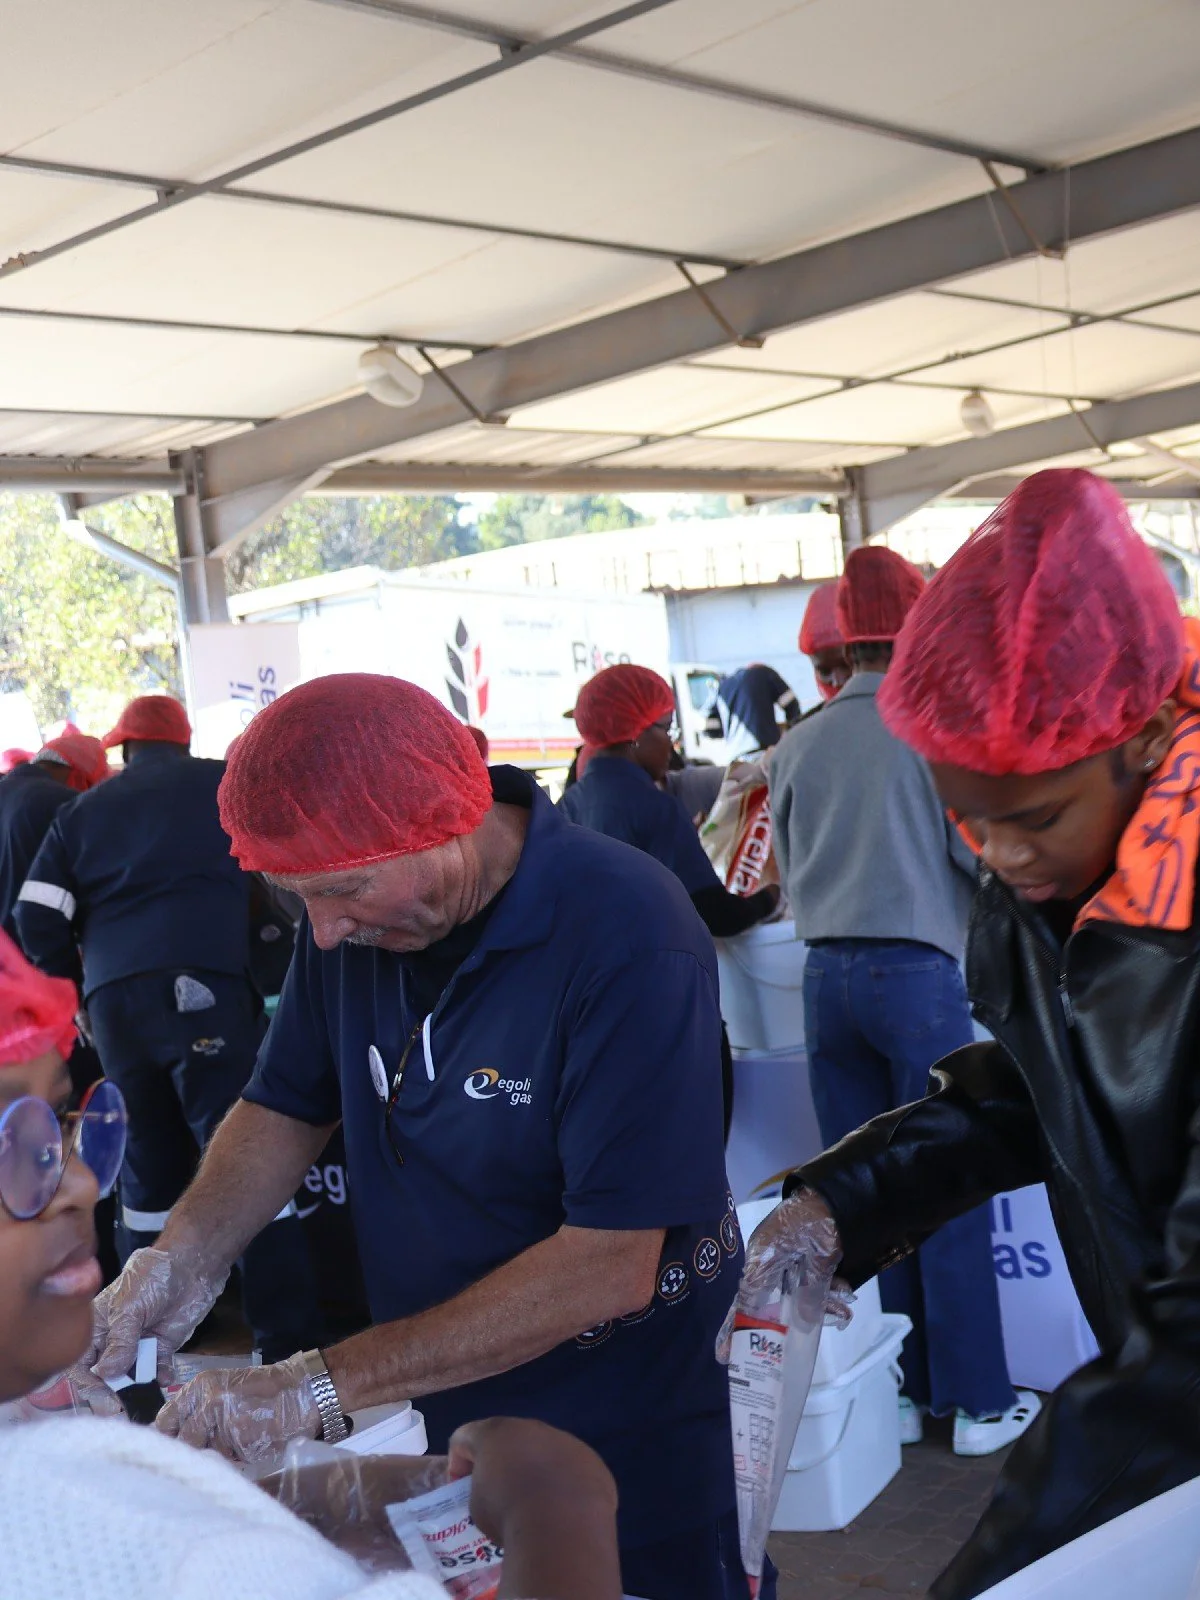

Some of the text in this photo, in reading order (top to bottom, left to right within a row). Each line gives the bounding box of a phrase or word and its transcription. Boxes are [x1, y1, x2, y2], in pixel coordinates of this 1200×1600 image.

[230, 682, 256, 726] oli
[259, 666, 276, 705] as
[498, 1078, 532, 1093] egoli
[509, 1092, 533, 1106] gas
[992, 1241, 1053, 1280] as
